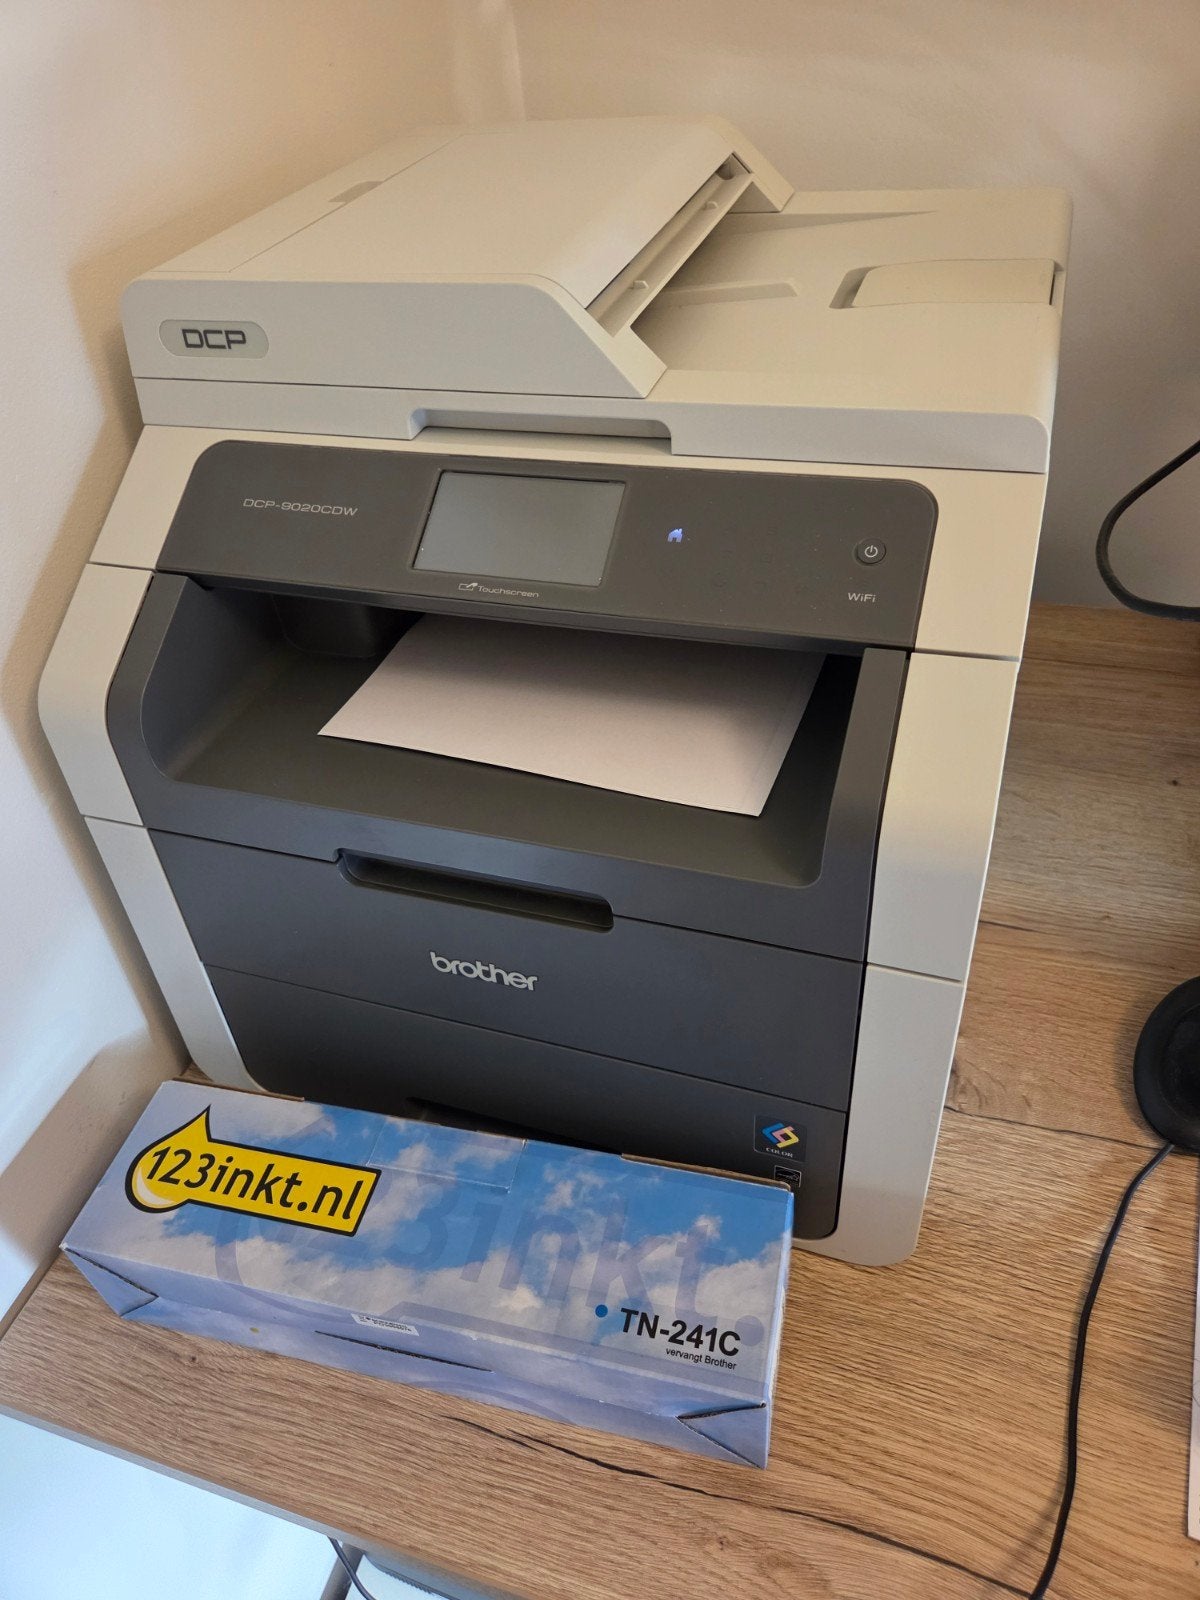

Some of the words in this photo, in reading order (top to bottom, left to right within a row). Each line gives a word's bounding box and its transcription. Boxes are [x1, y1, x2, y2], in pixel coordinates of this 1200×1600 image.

[181, 328, 247, 350] DCP
[242, 497, 359, 517] DCP-9020CDW
[477, 585, 540, 598] Touchscreen
[847, 592, 877, 603] WiFi
[429, 951, 538, 991] brother
[146, 1145, 365, 1220] 123inkt.nl
[620, 1307, 741, 1357] TN-241C
[665, 1347, 703, 1364] vervangt
[704, 1355, 737, 1370] Brother
